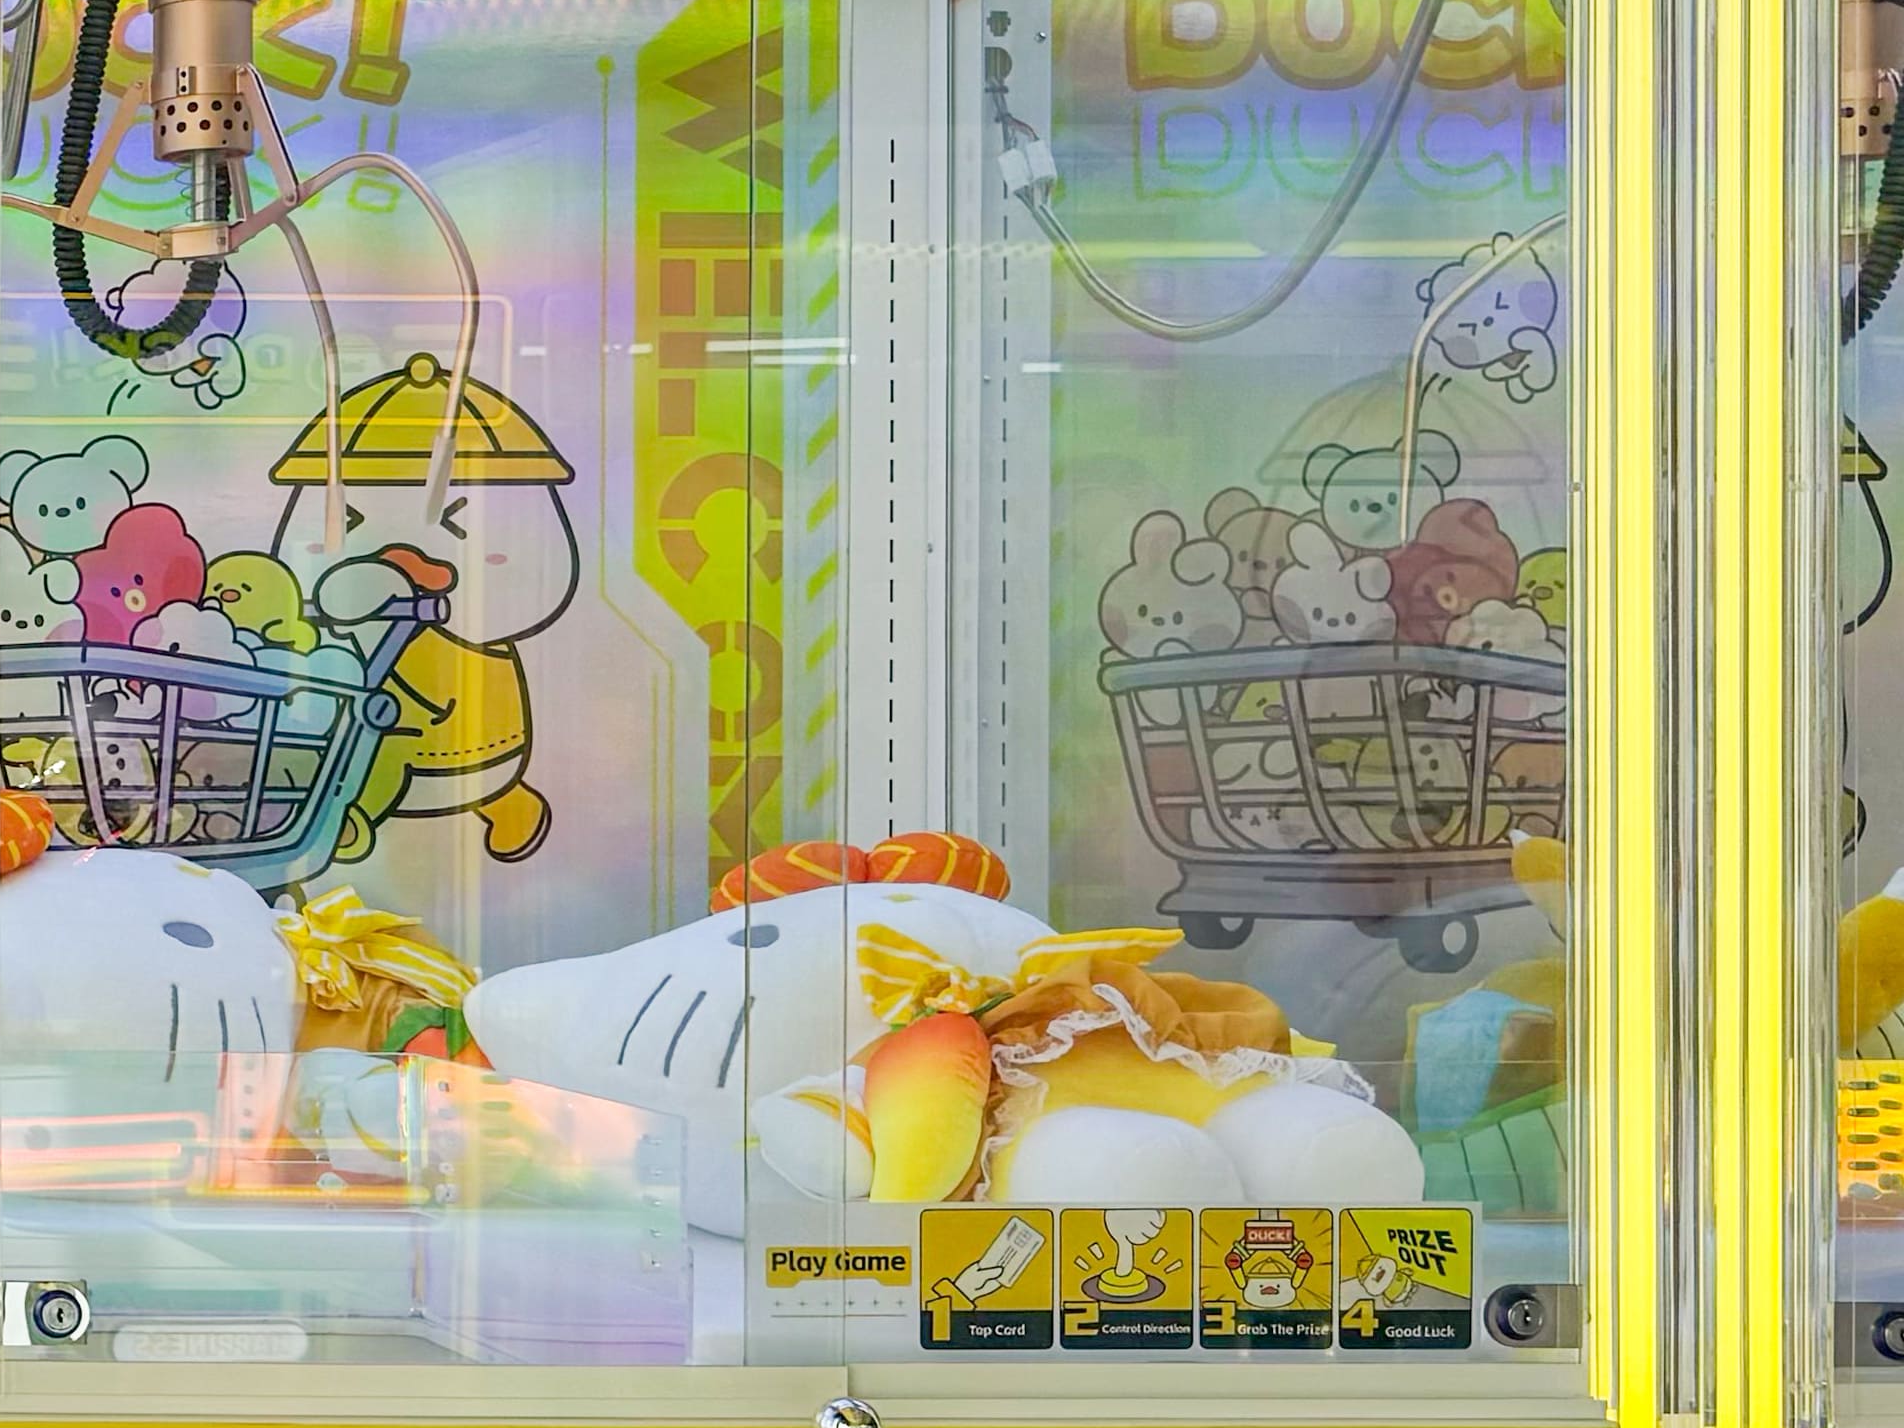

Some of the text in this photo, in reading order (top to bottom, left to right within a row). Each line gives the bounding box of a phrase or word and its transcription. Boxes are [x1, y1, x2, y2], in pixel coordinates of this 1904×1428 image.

[1388, 1228, 1458, 1254] PRIZE
[771, 1251, 906, 1277] Play Game
[1399, 1249, 1446, 1277] OUT
[925, 1295, 952, 1342] 1
[969, 1324, 1026, 1338] Tap Card
[1063, 1300, 1100, 1336] 2
[1102, 1323, 1191, 1335] Control Direction
[1202, 1300, 1237, 1336] 3
[1237, 1323, 1330, 1337] Grab The Prize
[1341, 1299, 1379, 1337] 4
[1385, 1324, 1455, 1338] Good Luck
